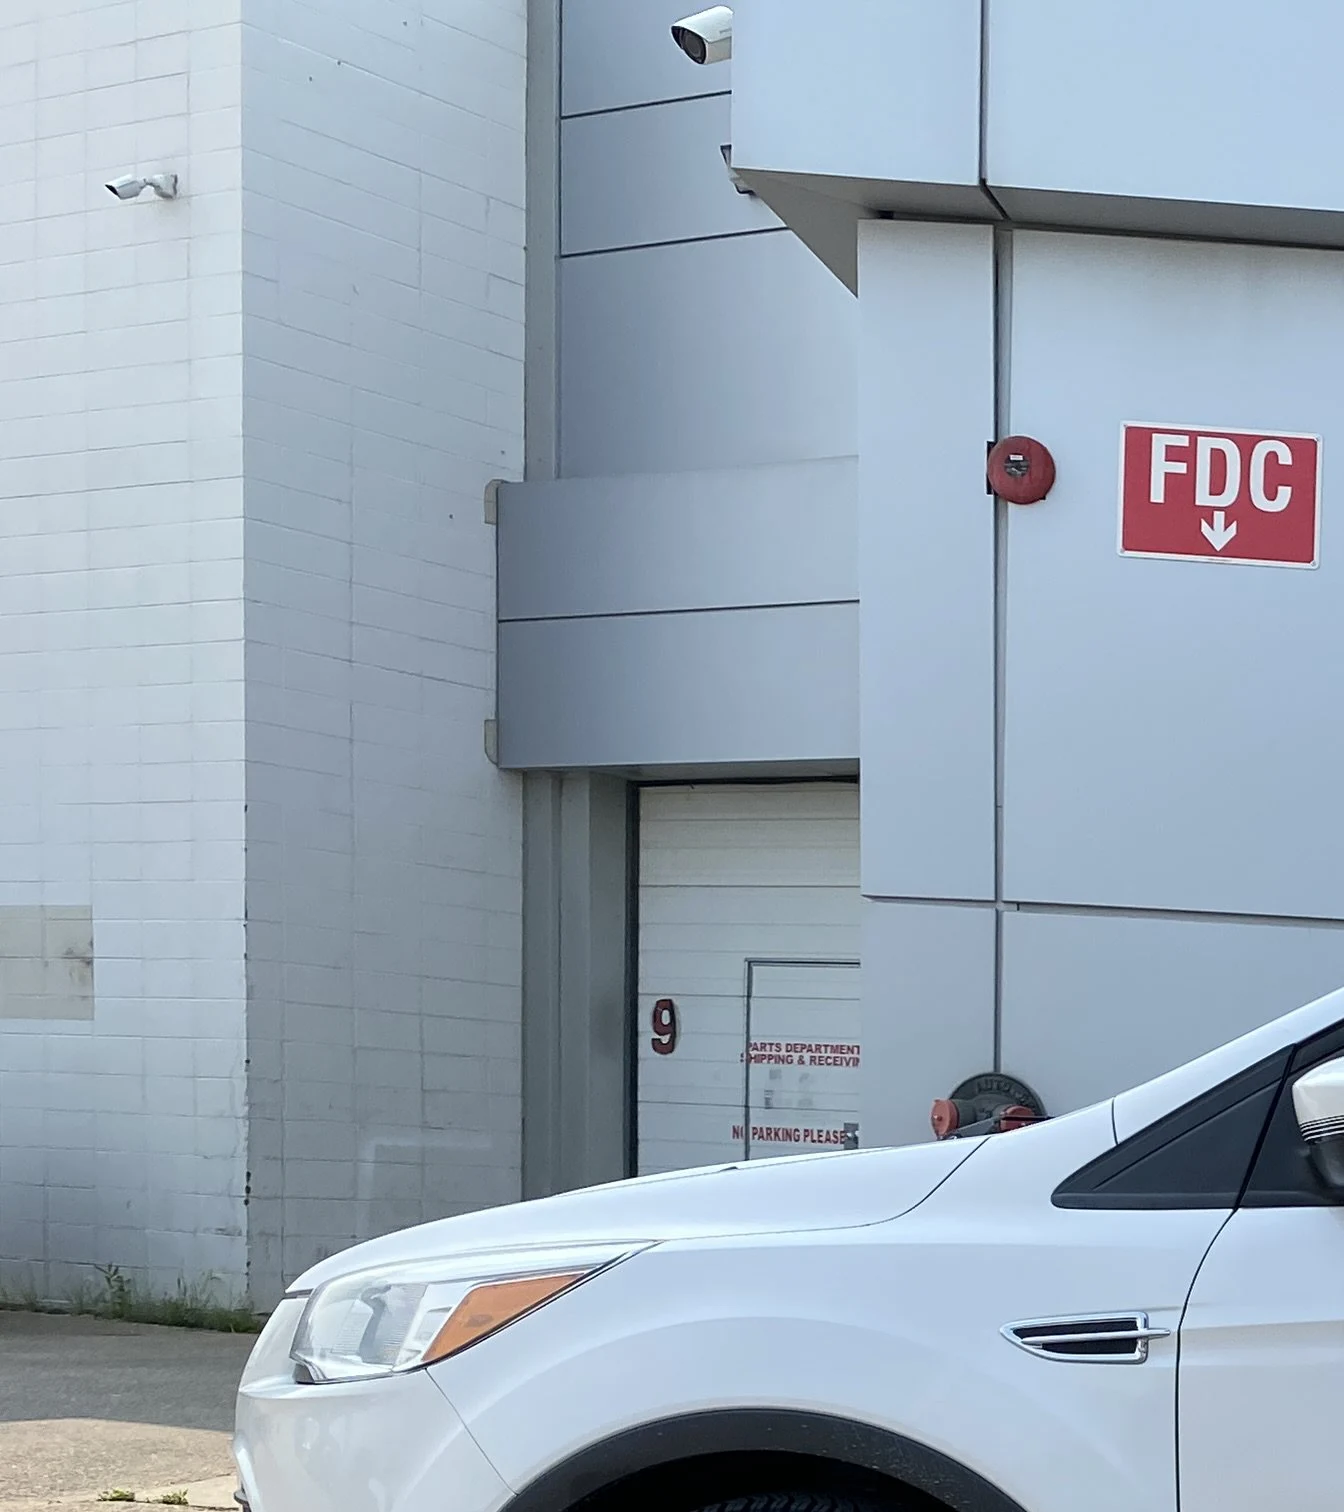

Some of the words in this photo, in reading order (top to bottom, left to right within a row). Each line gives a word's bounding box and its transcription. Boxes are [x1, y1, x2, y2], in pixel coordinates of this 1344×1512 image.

[1149, 432, 1293, 513] FDC
[651, 998, 676, 1055] 9
[785, 1043, 861, 1056] DEPARTMENT
[797, 1055, 806, 1066] &
[752, 1126, 801, 1143] PARKING
[803, 1128, 846, 1145] PLEASE
